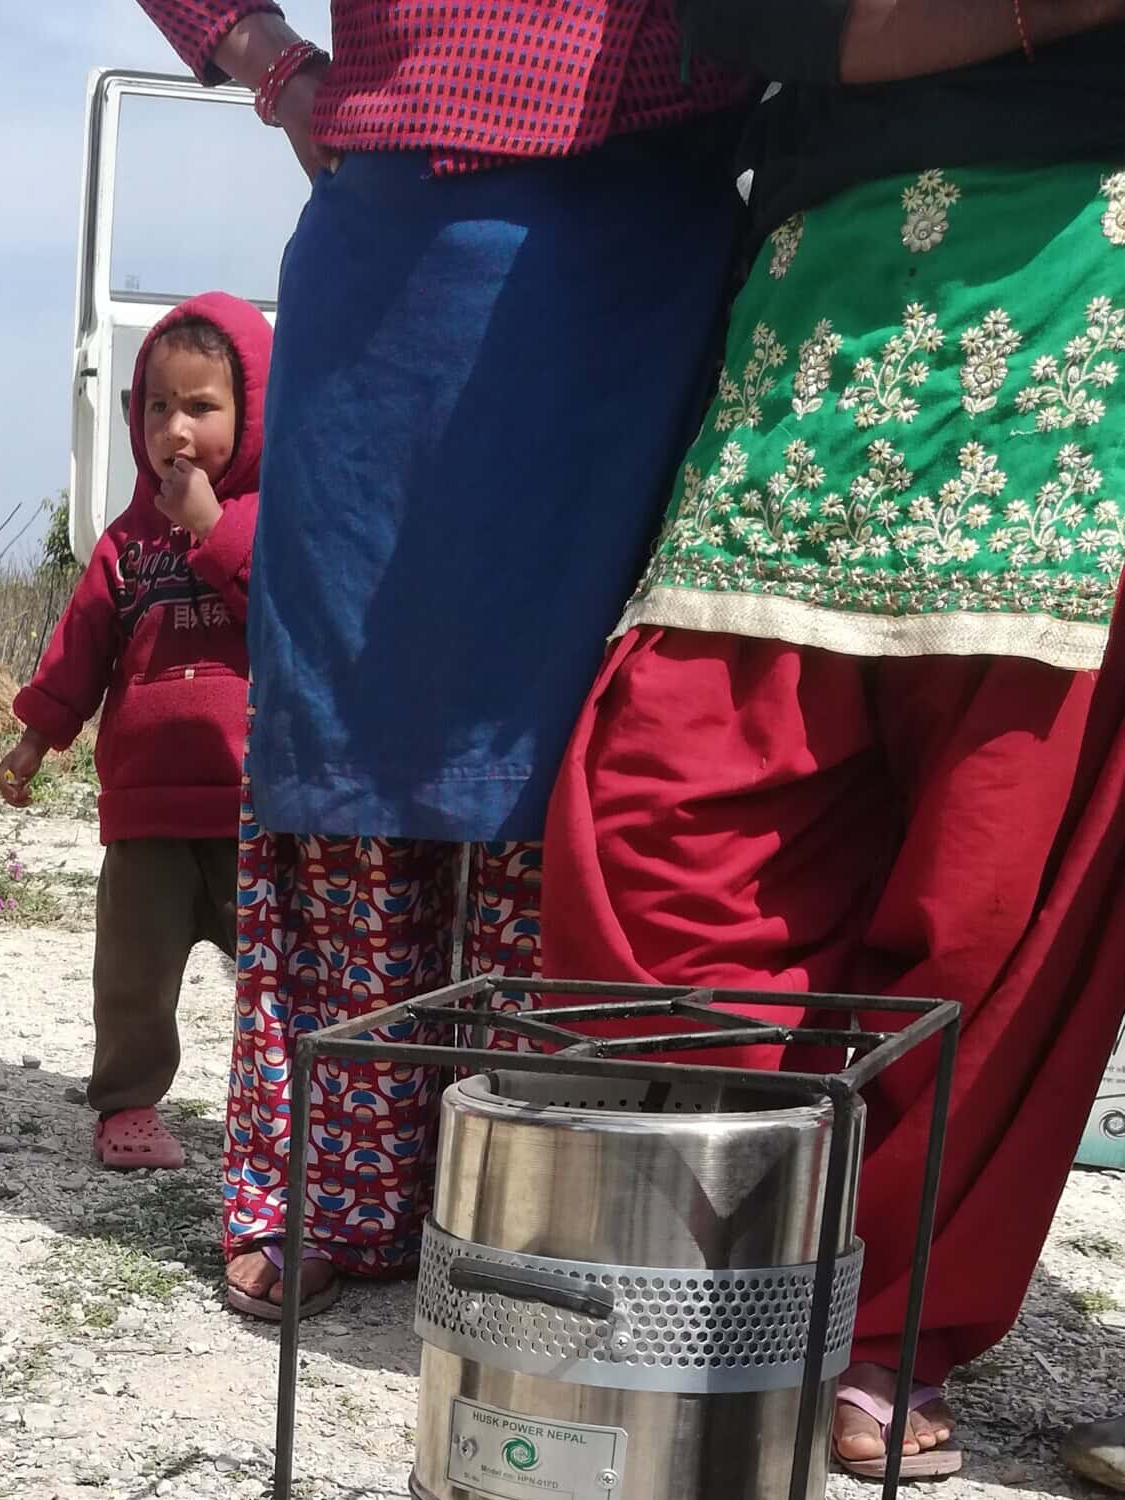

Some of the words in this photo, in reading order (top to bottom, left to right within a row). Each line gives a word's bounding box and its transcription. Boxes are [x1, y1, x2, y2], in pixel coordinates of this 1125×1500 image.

[473, 1411, 499, 1428] HUSK
[502, 1420, 544, 1437] POWER
[547, 1429, 587, 1445] NEPAL
